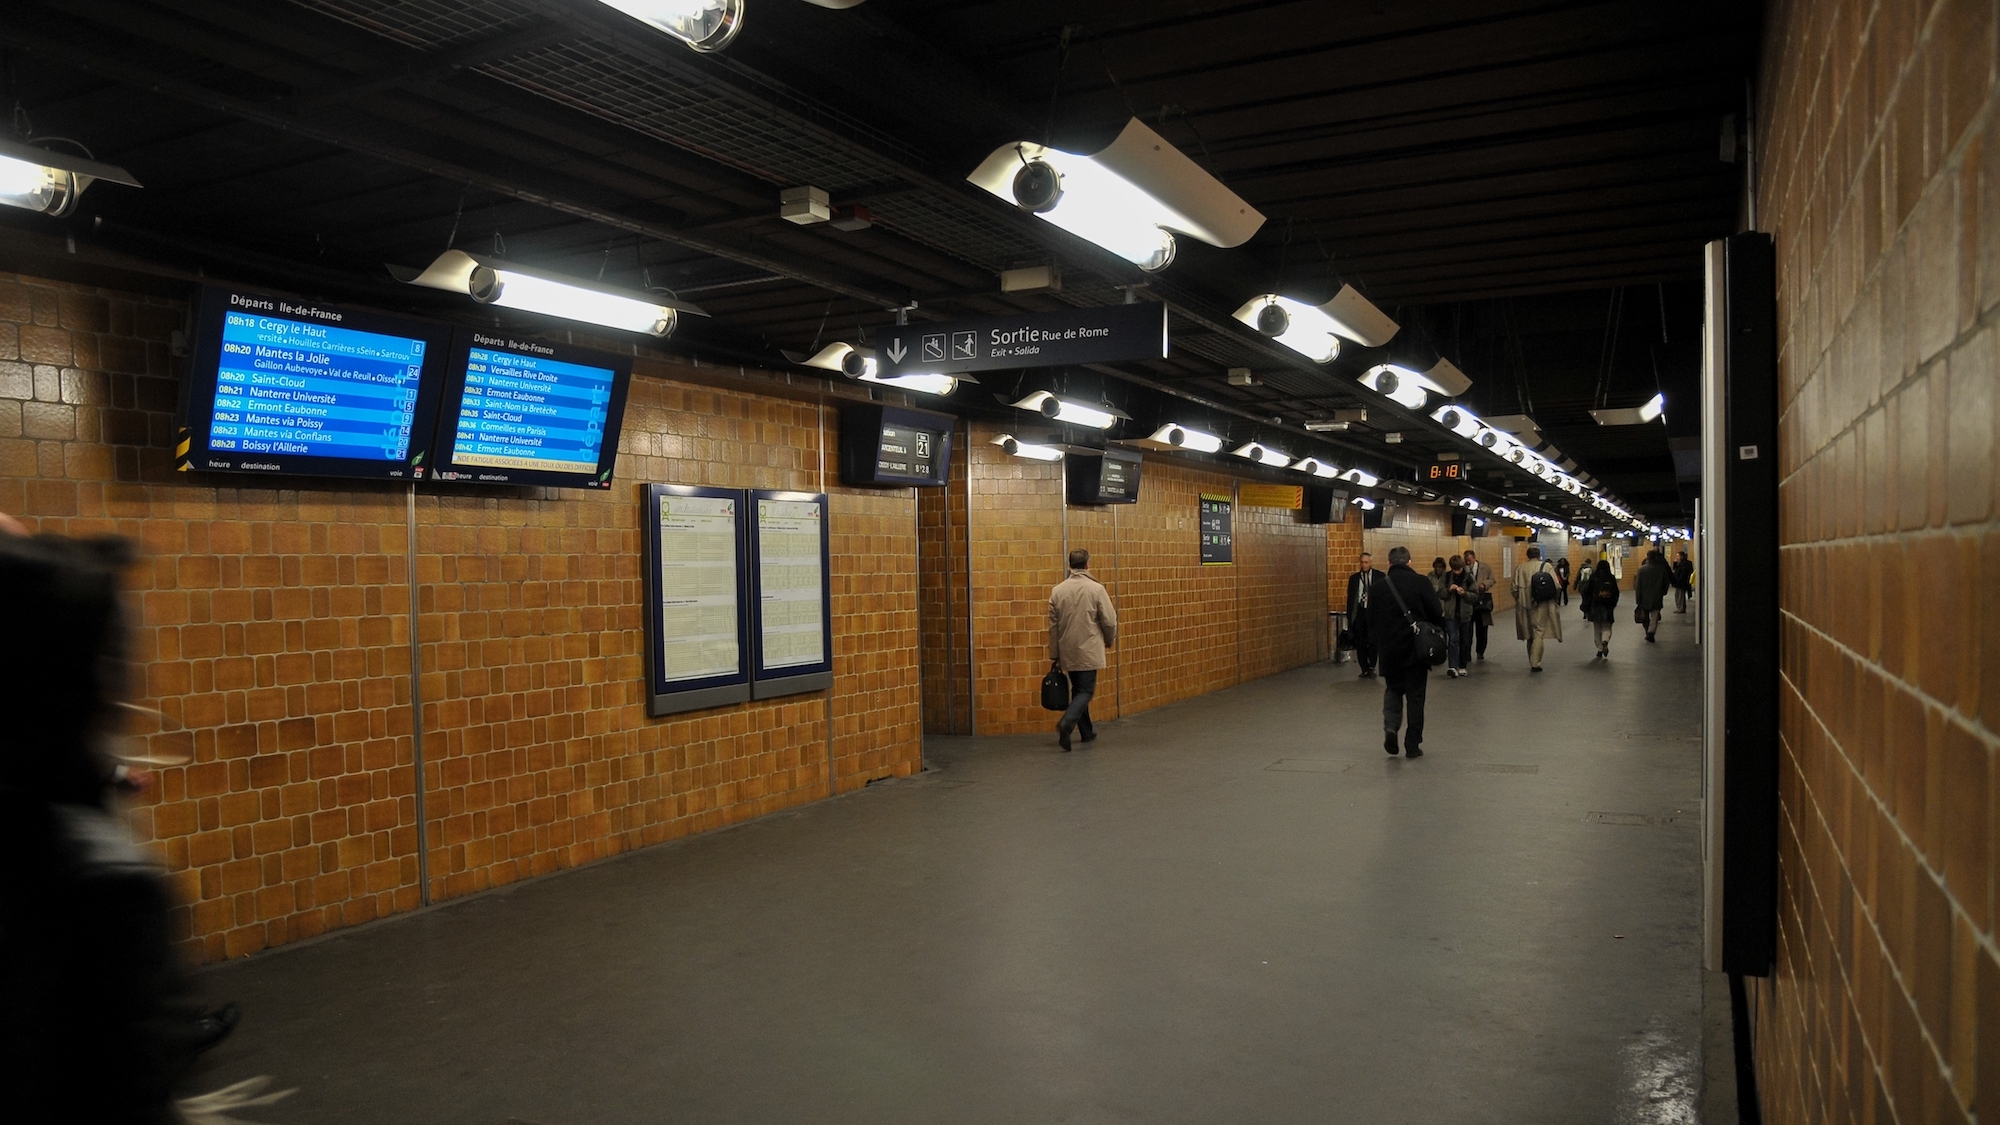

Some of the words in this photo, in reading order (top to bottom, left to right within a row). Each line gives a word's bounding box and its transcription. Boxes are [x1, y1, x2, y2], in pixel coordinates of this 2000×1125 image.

[231, 294, 274, 310] Départs
[280, 302, 342, 321] Ile-de-France
[228, 316, 255, 328] 08h18
[259, 318, 289, 334] Cergy
[291, 323, 300, 334] le
[302, 325, 327, 338] Haut
[990, 326, 1040, 346] Sortie
[1042, 330, 1061, 341] Rue
[1064, 328, 1076, 340] de
[1080, 327, 1109, 338] Rome
[288, 336, 320, 349] Houilles
[322, 341, 355, 354] Carrières
[474, 334, 505, 346] Départs
[508, 340, 554, 355] Ile-de-France
[990, 348, 1006, 358] Exit
[1014, 346, 1040, 356] Salida
[224, 343, 251, 355] 08h20
[256, 346, 294, 360] Mantes
[296, 351, 304, 362] la
[306, 352, 330, 365] Jolie
[492, 354, 512, 366] Cergy
[520, 359, 536, 368] Haut
[254, 358, 283, 370] Gaillon
[284, 363, 323, 376] Aubevoye
[328, 368, 341, 377] Val
[342, 370, 352, 378] de
[353, 371, 372, 382] Reuil
[376, 374, 398, 384] Oissel
[409, 368, 419, 376] 24
[491, 364, 522, 378] Versailles
[522, 370, 537, 380] Rive
[538, 372, 558, 383] Droite
[220, 371, 245, 381] 08h20
[252, 374, 306, 388] Saint-Cloud
[488, 376, 518, 388] Nanterre
[520, 382, 552, 393] Université
[219, 385, 242, 394] 08h21
[250, 386, 291, 400] Nanterre
[292, 391, 336, 404] Université
[486, 388, 512, 398] Ermont
[513, 392, 545, 403] Eaubonne
[217, 398, 241, 408] 08h22
[248, 400, 282, 413] Ermont
[284, 404, 328, 416] Eaubonne
[484, 400, 520, 412] Saint-Nom
[522, 404, 528, 412] la
[215, 412, 240, 422] 08h23
[246, 413, 280, 425] Mantes
[282, 417, 294, 426] via
[297, 418, 324, 430] Poissy
[483, 410, 522, 422] Saint-Cloud
[580, 384, 605, 461] départ
[213, 426, 238, 435] 08h23
[244, 427, 278, 438] Mantes
[280, 430, 293, 440] via
[294, 430, 332, 442] Conflans
[481, 422, 516, 433] Cormeilles
[526, 428, 547, 436] Parisis
[211, 440, 236, 449] 08h28
[242, 440, 272, 453] Boissy
[479, 432, 510, 443] Nanterre
[510, 436, 542, 446] Université
[477, 444, 502, 454] Ermont
[504, 446, 536, 456] Eaubonne
[918, 442, 928, 455] 21
[208, 460, 231, 469] heure
[241, 462, 280, 471] destination
[1430, 464, 1458, 478] 8:18
